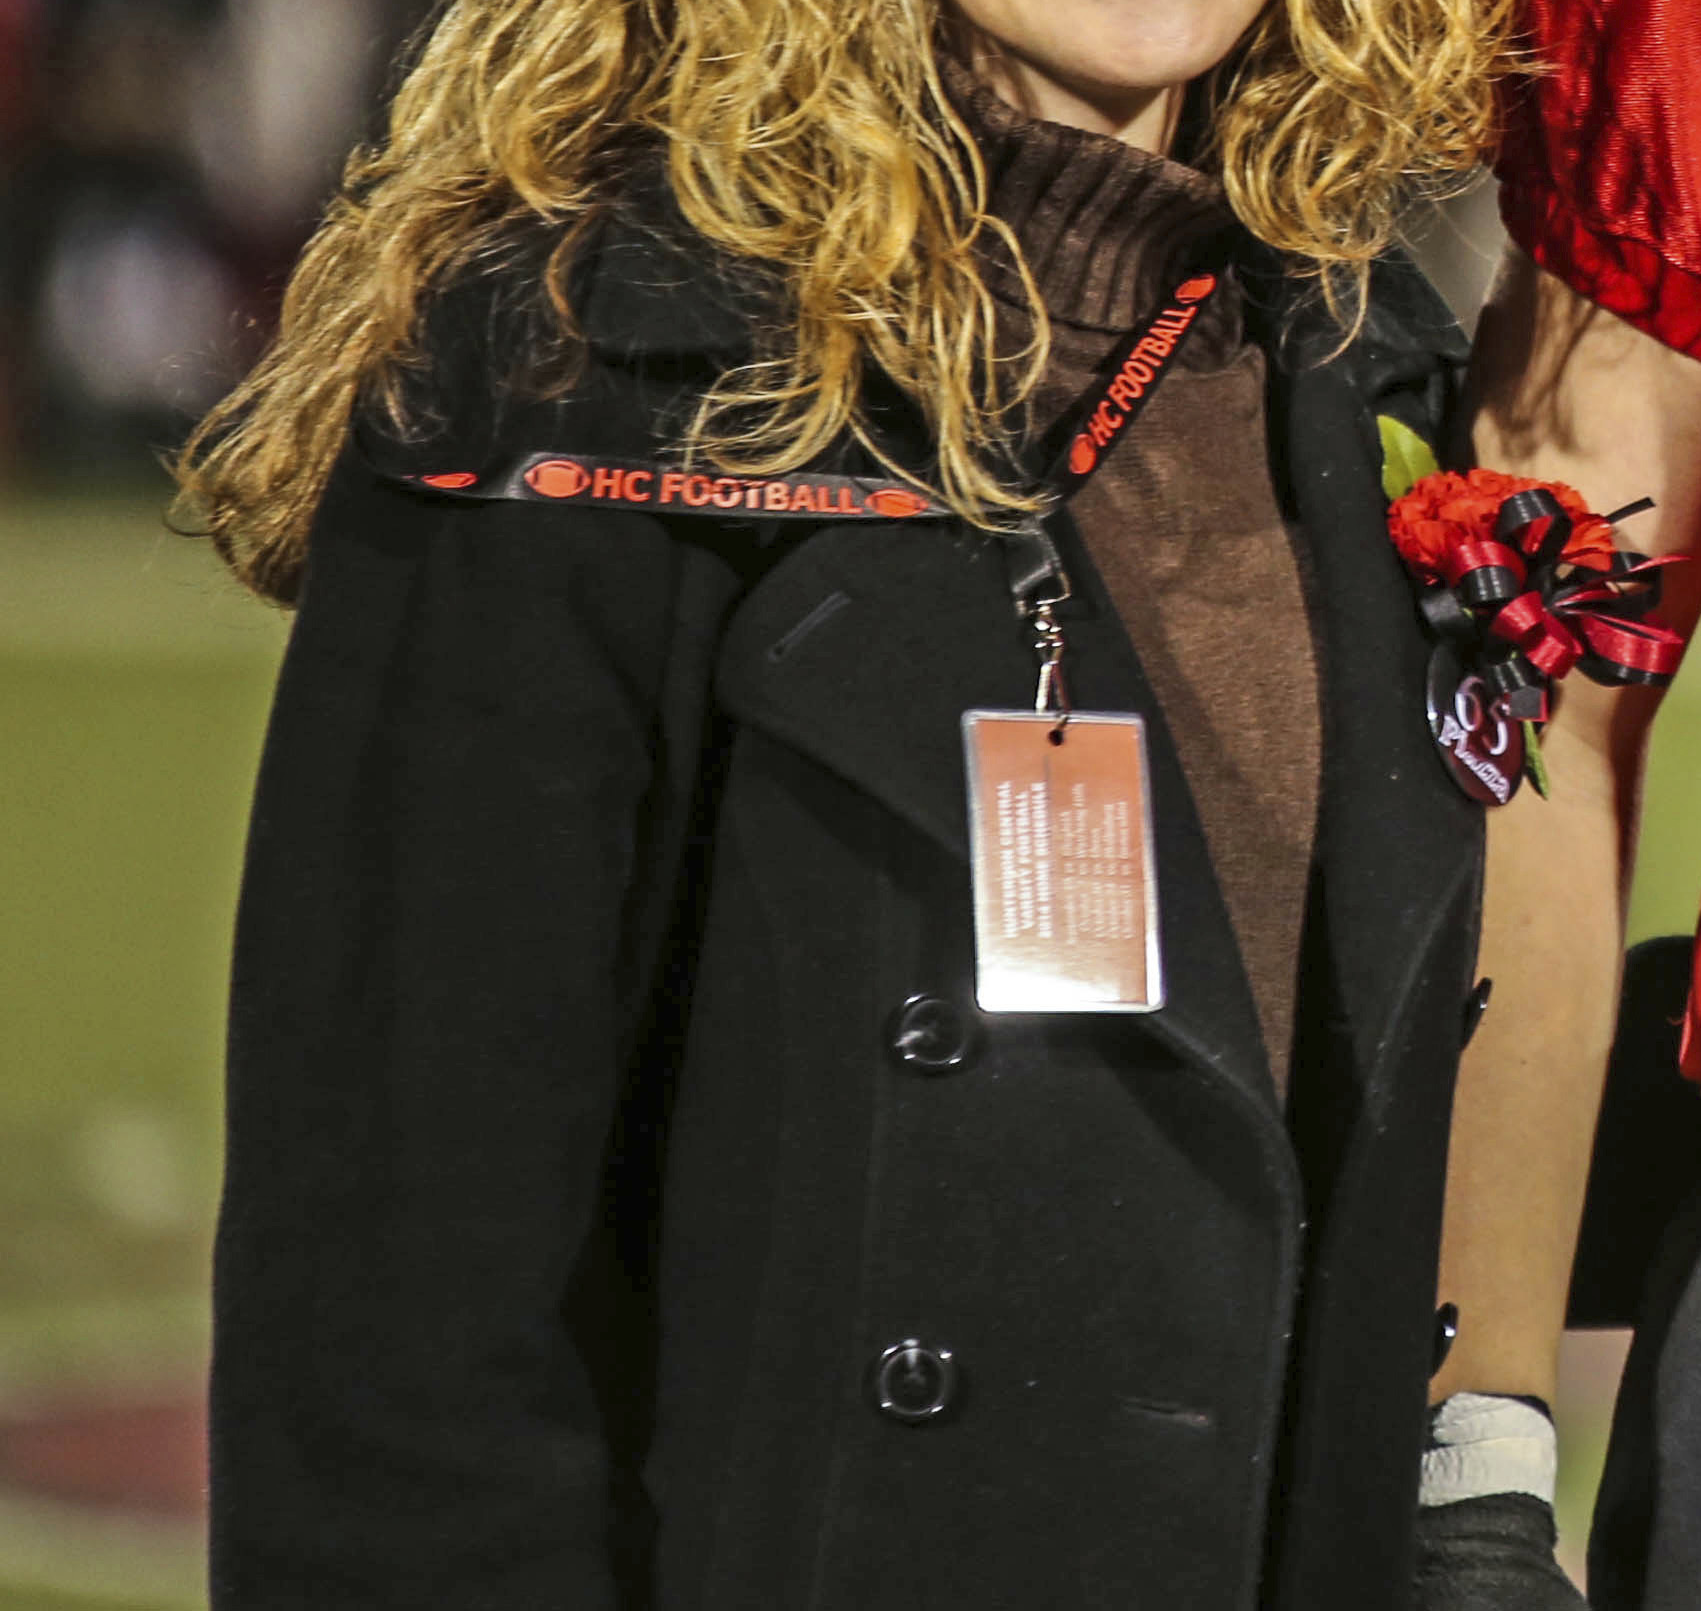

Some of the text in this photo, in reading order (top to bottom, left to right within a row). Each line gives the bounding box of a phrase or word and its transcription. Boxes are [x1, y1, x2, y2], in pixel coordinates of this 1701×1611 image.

[1088, 306, 1198, 446] HC FOOTBALL
[593, 468, 864, 514] HC FOOTBALL
[1015, 791, 1032, 865] FOOTBALL
